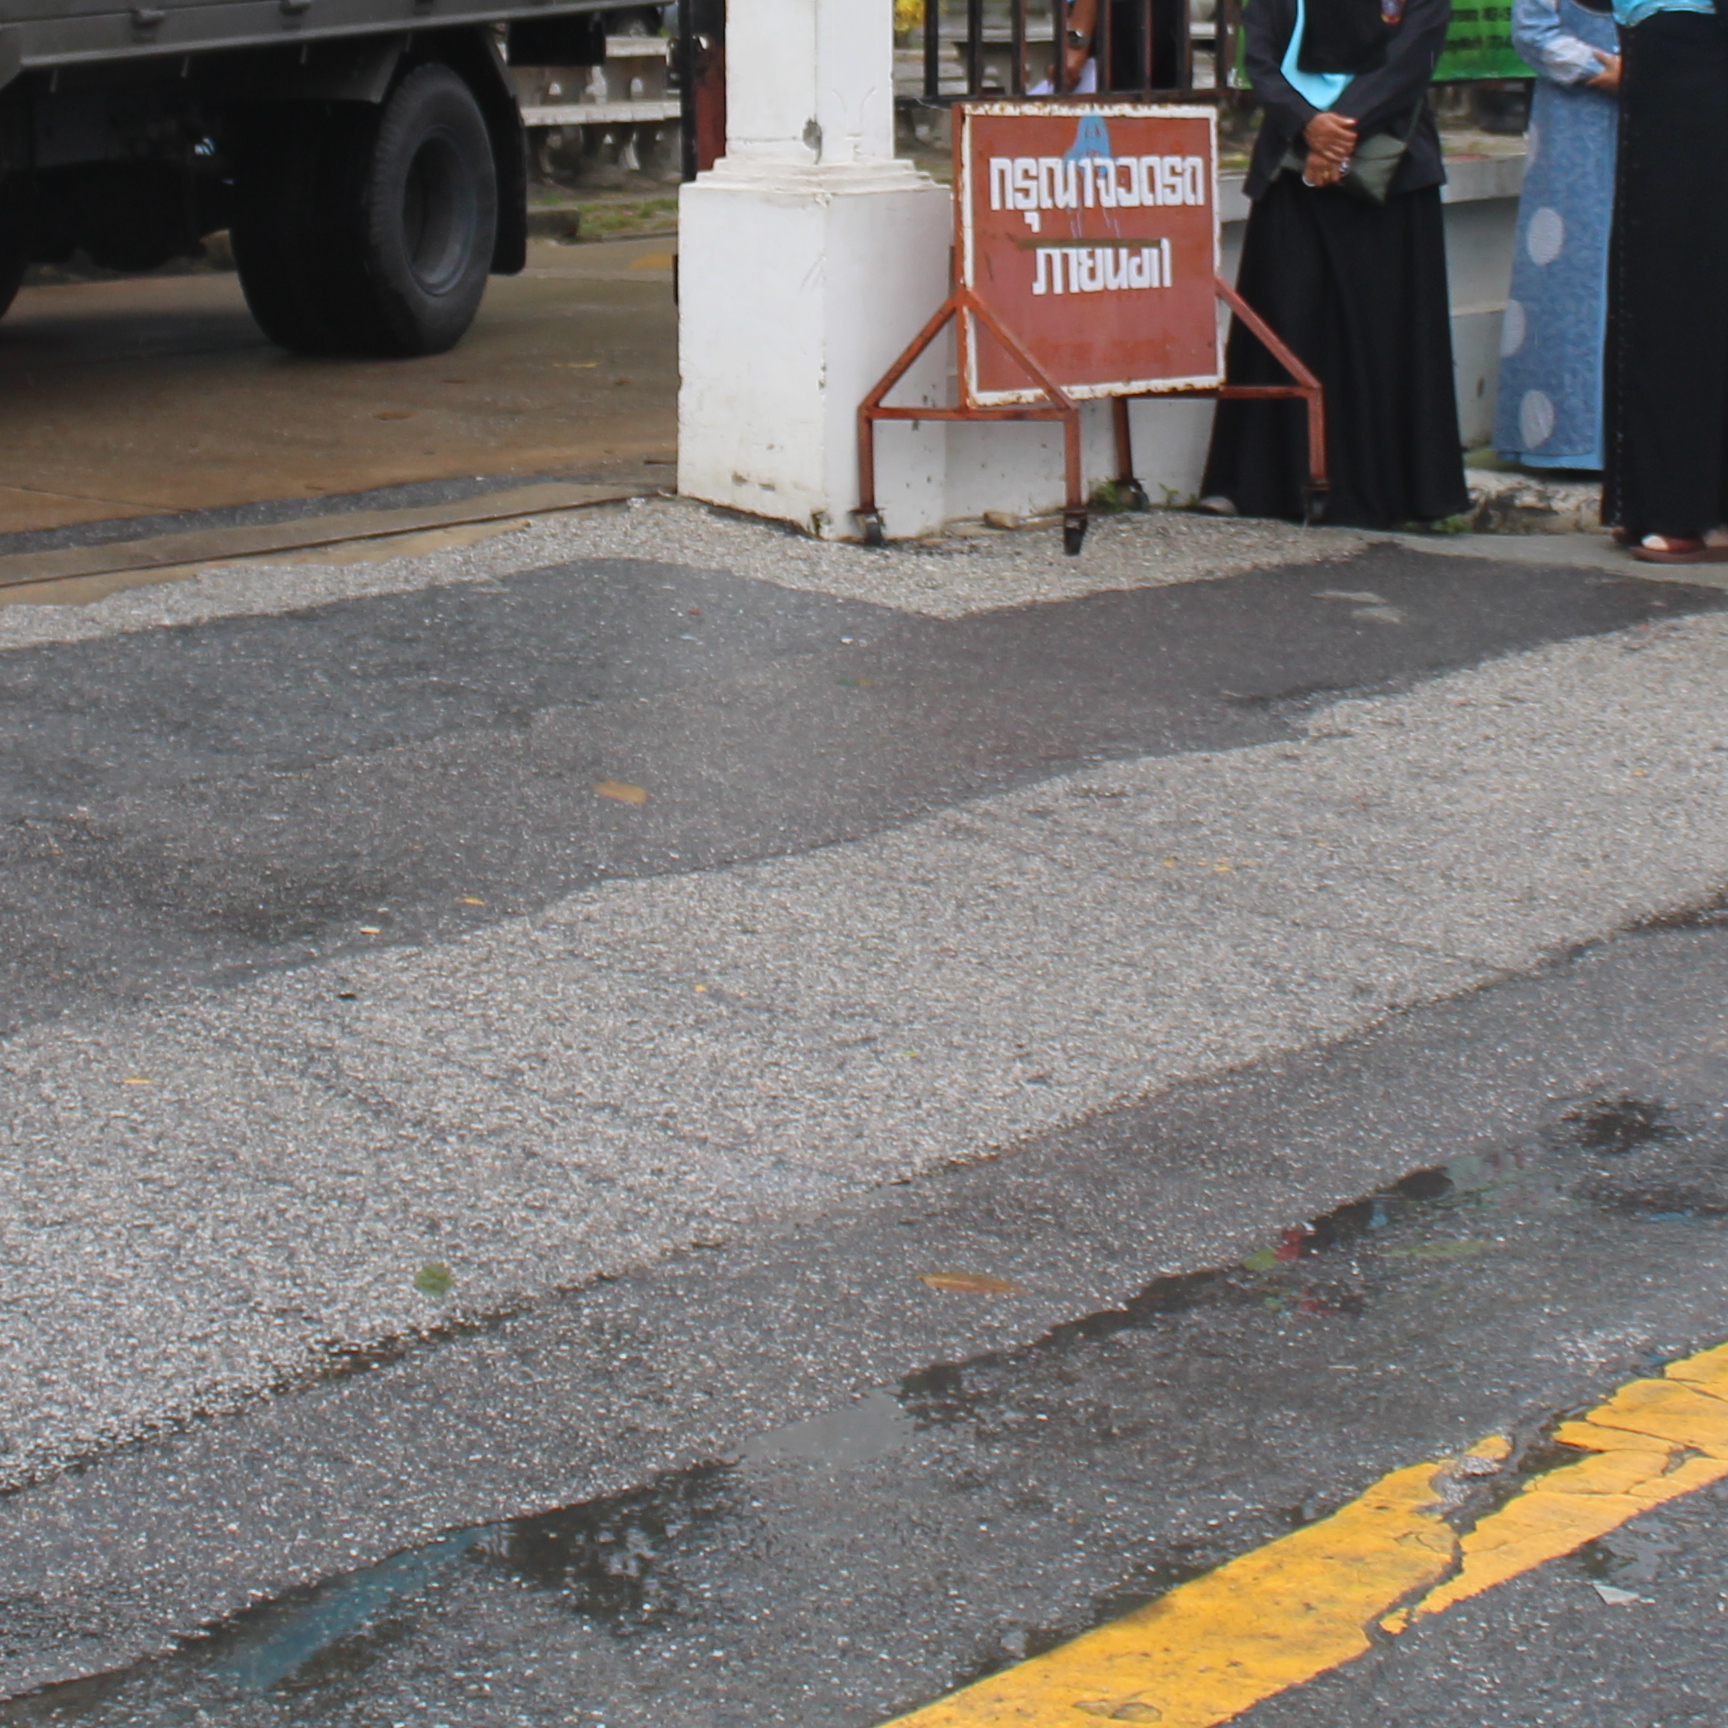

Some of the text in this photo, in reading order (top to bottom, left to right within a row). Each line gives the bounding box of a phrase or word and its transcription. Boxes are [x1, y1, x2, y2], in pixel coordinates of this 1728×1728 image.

[988, 154, 1205, 233] กรุณาจอดรถ
[1031, 238, 1172, 296] ภายนอก
